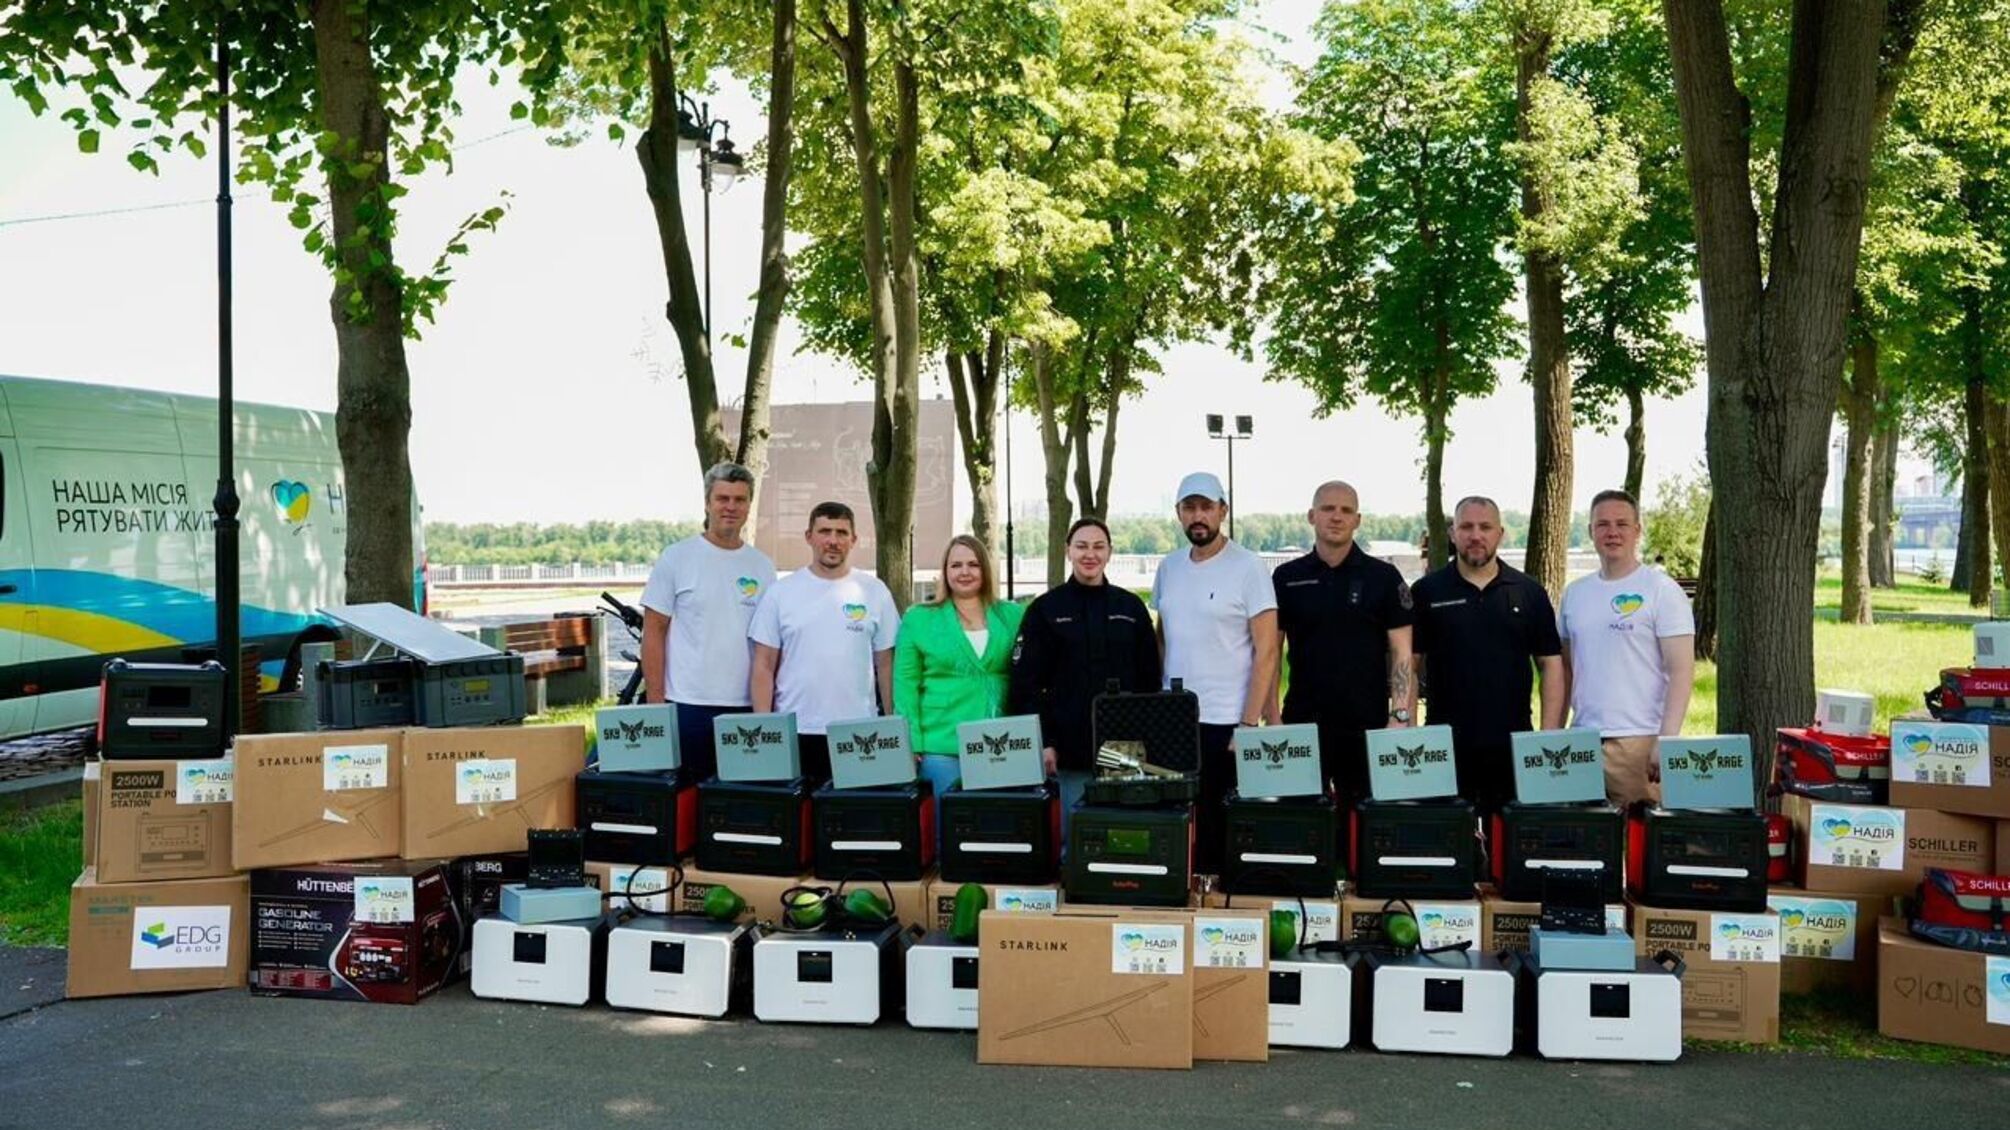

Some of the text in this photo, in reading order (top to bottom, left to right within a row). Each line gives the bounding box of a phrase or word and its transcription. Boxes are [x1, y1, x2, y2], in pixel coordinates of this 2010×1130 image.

[52, 479, 188, 504] НАША МІСІЯ
[57, 508, 216, 533] РЯТУВАТИ ЖИТ
[1974, 681, 2010, 691] SCHILL
[604, 725, 665, 741] SKY RAGE
[721, 731, 783, 746] SKY RAGE
[836, 736, 900, 754] SKY RAGE
[966, 737, 1032, 755] SKY RAGE
[1935, 742, 1979, 755] НАДІЯ
[427, 750, 486, 761] STARLINK
[1243, 745, 1312, 761] SKY RAGE
[1379, 749, 1448, 767] SKY RAGE
[1524, 750, 1596, 768] SKY RAGE
[258, 755, 322, 767] STARLINK
[353, 756, 382, 767] НАДІЯ
[1668, 755, 1744, 770] SKY RAGE
[115, 774, 160, 787] 2500W
[207, 771, 233, 782] НАДІ
[483, 771, 511, 782] НАДІЯ
[111, 790, 161, 800] PORTABLE
[110, 799, 151, 808] STATION
[1853, 826, 1895, 839] НАДІЯ
[1908, 837, 1978, 852] SCHILLER
[297, 877, 355, 893] HÜTTENBE
[634, 881, 661, 890] НАДІЯ
[380, 890, 408, 899] НАДІЯ
[1023, 902, 1052, 910] НАДІЯ
[259, 907, 322, 920] GASOLINE
[259, 919, 333, 932] GENERATOR
[1306, 916, 1331, 926] АДІЯ
[1444, 918, 1474, 928] НАДІЯ
[1806, 915, 1847, 930] НАДІЯ
[176, 926, 221, 945] EDG
[1649, 923, 1693, 936] 2500W
[1742, 928, 1774, 938] НАДІЯ
[1224, 931, 1257, 942] НАДІЯ
[1000, 940, 1068, 951] STARLINK
[1144, 938, 1178, 949] НАДІЯ
